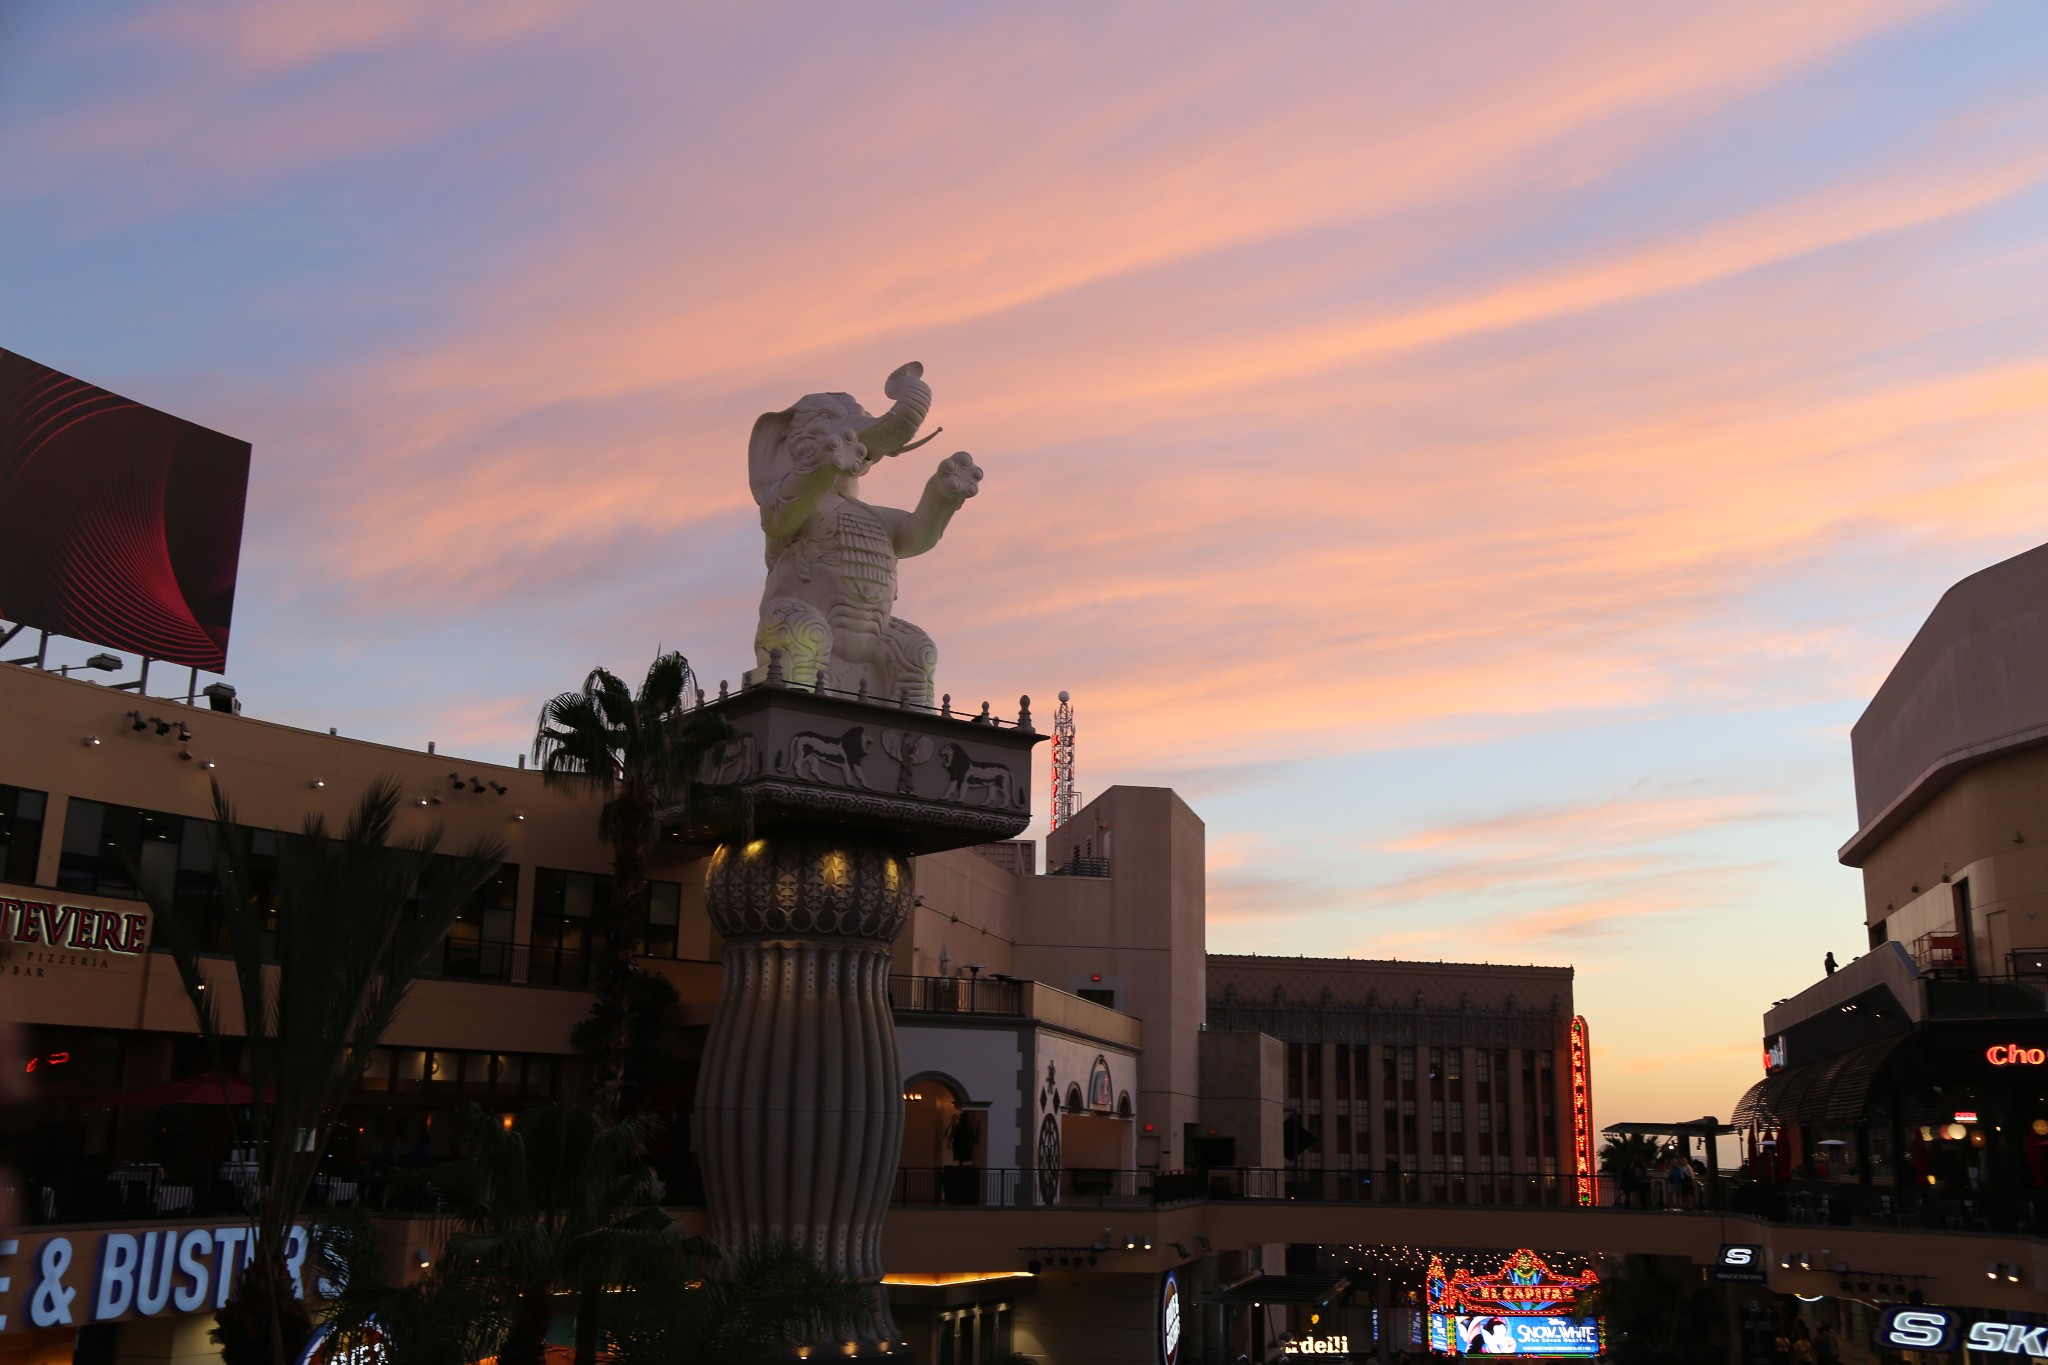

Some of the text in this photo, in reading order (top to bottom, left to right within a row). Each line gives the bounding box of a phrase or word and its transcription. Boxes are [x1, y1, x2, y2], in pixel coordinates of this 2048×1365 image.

[27, 951, 108, 969] PIZZERIA
[30, 1236, 77, 1328] &
[1966, 1322, 2048, 1358] SK
